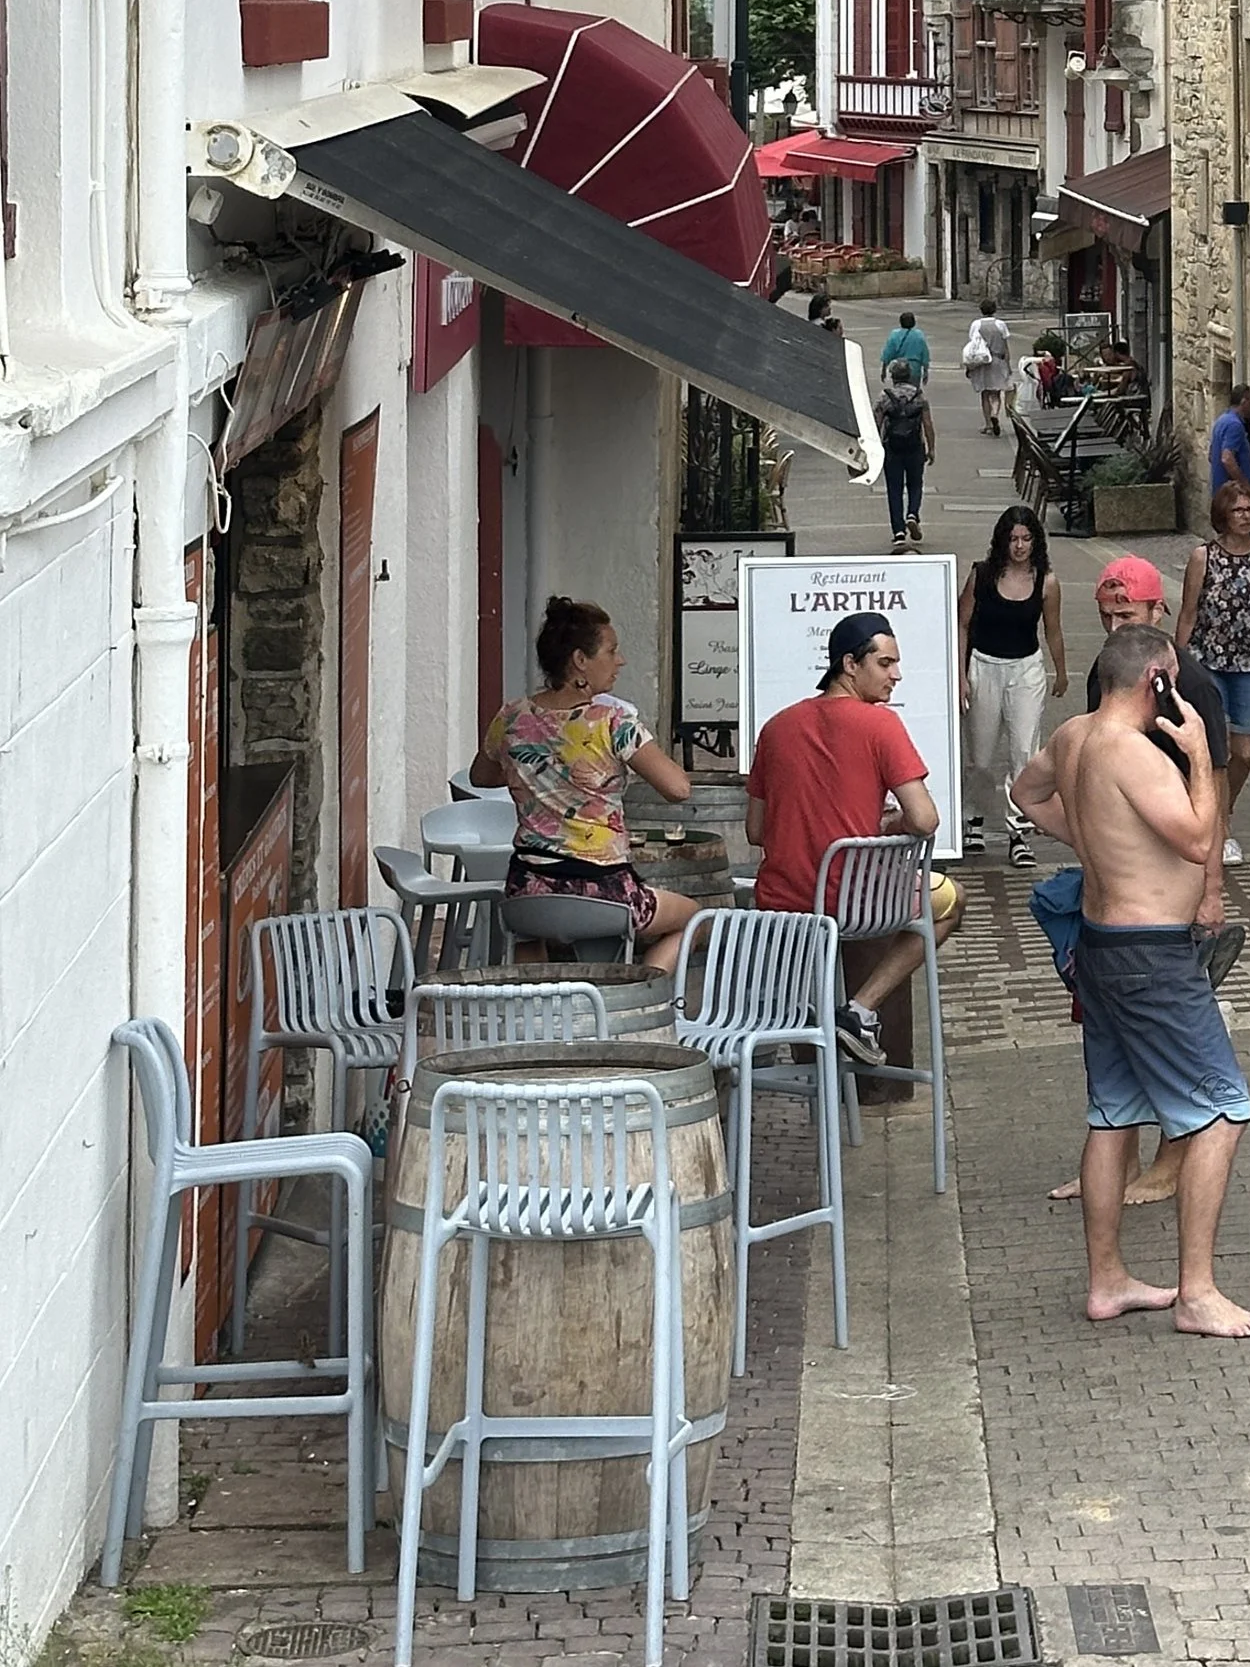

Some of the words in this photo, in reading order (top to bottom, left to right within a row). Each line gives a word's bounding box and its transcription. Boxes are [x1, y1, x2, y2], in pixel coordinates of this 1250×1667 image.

[810, 570, 887, 587] Restaurant
[790, 589, 908, 613] L'ARTHA
[687, 659, 730, 679] Linge
